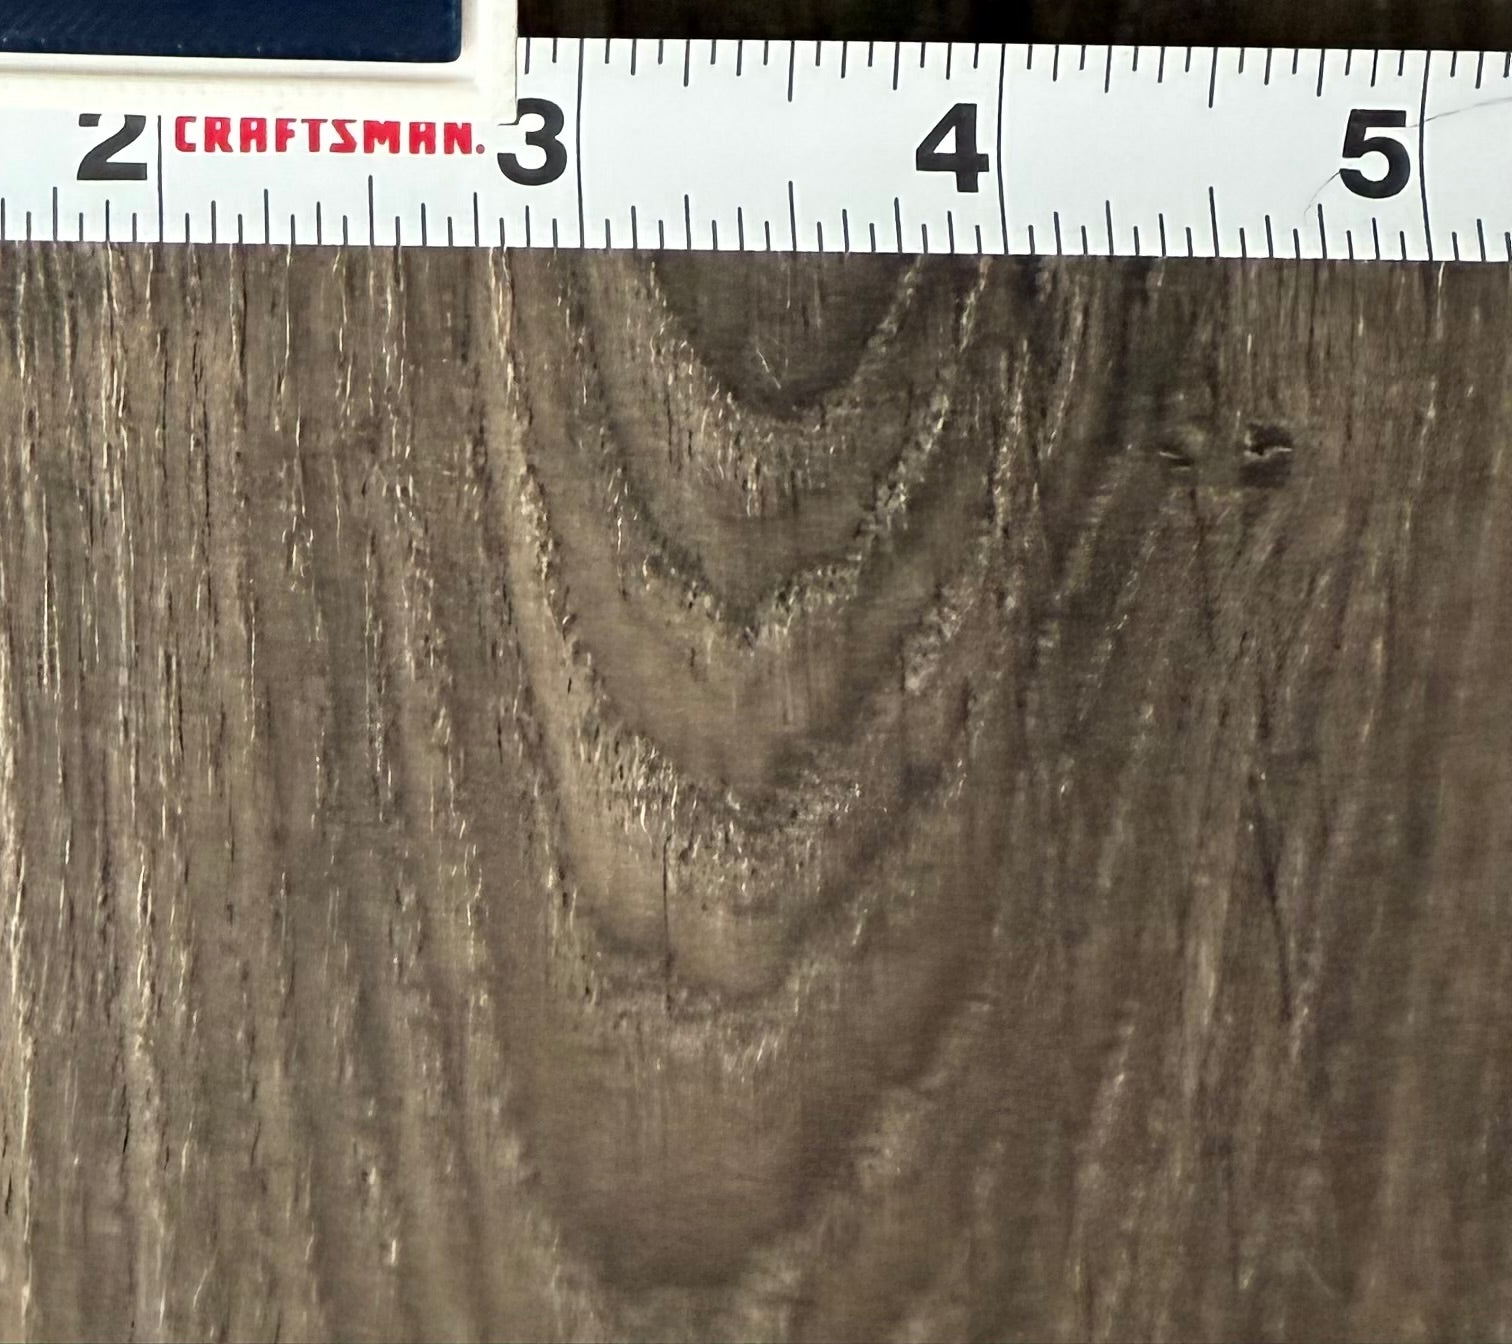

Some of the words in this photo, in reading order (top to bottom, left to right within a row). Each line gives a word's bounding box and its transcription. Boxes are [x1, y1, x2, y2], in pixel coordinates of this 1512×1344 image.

[76, 113, 148, 181] 2
[496, 98, 568, 186] 3
[915, 103, 990, 193] 4
[1338, 108, 1411, 199] 5
